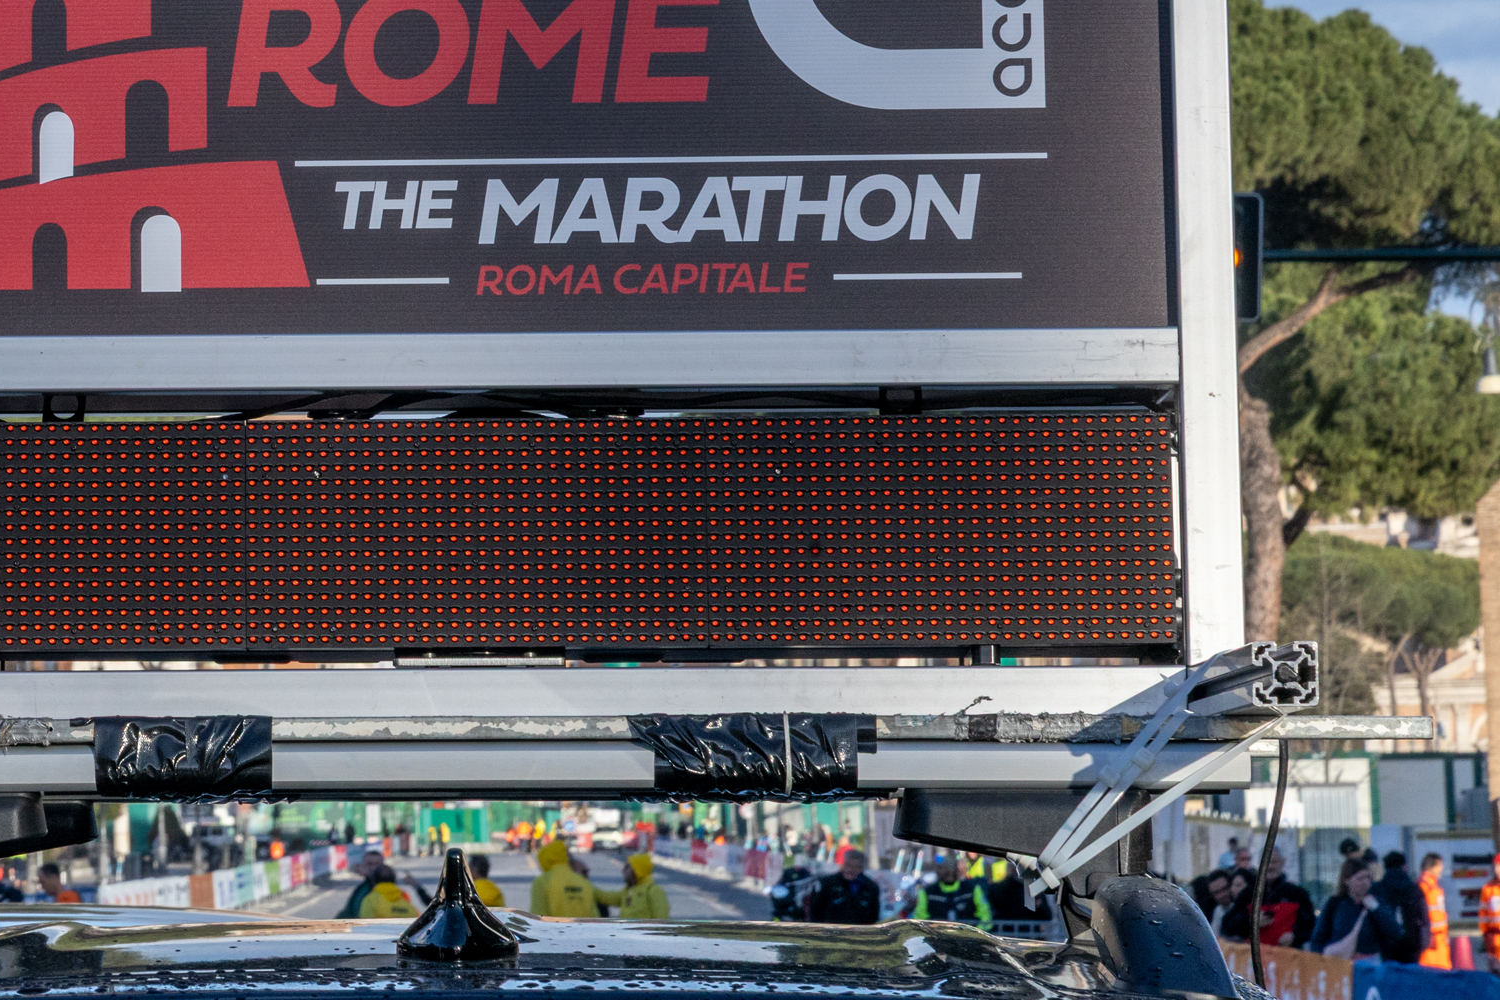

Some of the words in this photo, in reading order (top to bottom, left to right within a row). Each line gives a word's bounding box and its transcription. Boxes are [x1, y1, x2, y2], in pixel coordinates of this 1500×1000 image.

[334, 180, 460, 231] THE
[478, 173, 982, 246] MARATHON
[476, 265, 603, 297] ROMA
[613, 262, 810, 295] CAPITALE
